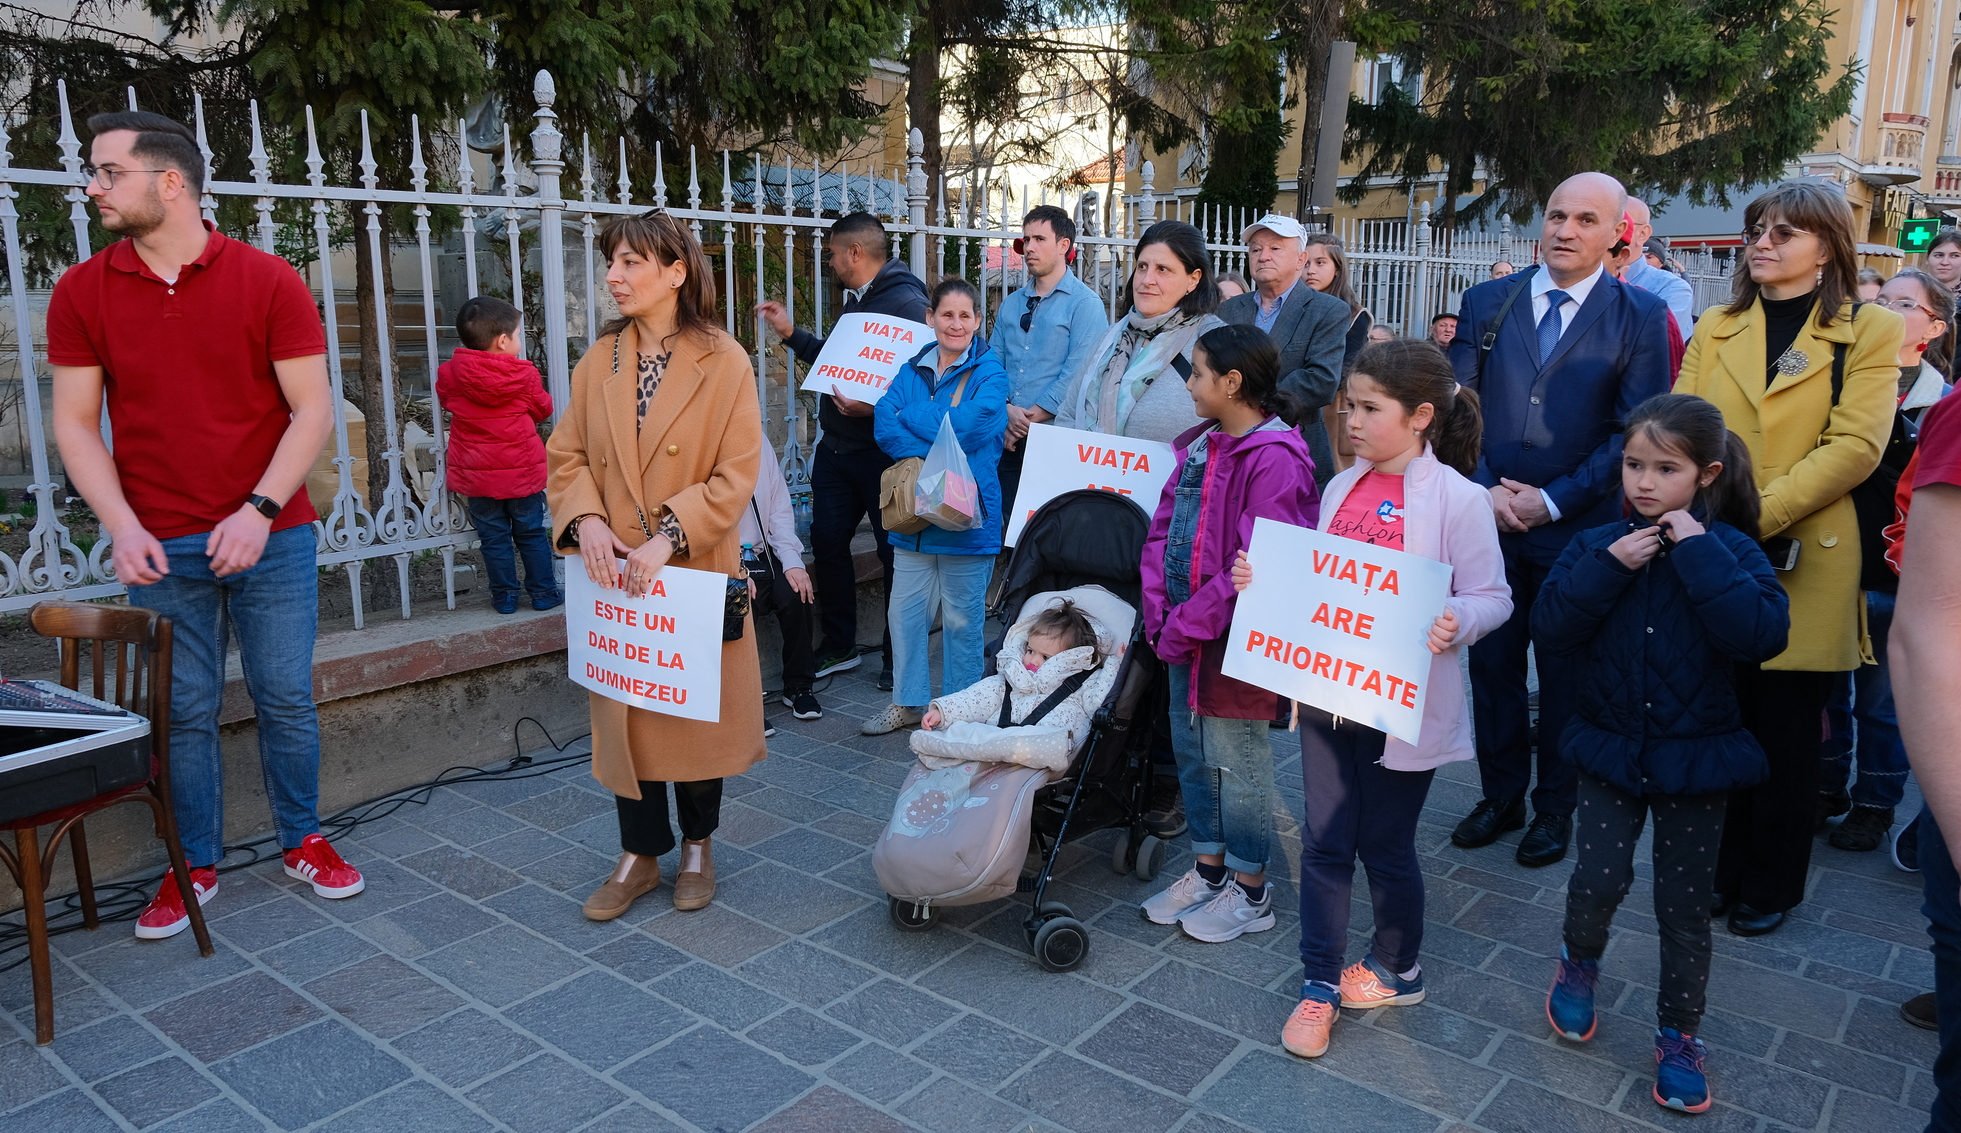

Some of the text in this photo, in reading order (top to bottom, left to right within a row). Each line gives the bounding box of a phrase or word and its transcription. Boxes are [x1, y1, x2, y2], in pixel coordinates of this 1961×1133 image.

[863, 321, 914, 344] VIAȚA
[857, 346, 897, 365] ARE
[1077, 444, 1150, 476] VIAȚA
[1331, 509, 1404, 544] ashion
[1312, 549, 1400, 596] VIAȚA
[594, 600, 676, 634] ESTE UN
[1310, 602, 1375, 640] ARE
[588, 630, 685, 671] DAR DE LA
[586, 662, 687, 705] DUMNEZEU
[1245, 630, 1419, 709] PRIORITATE
